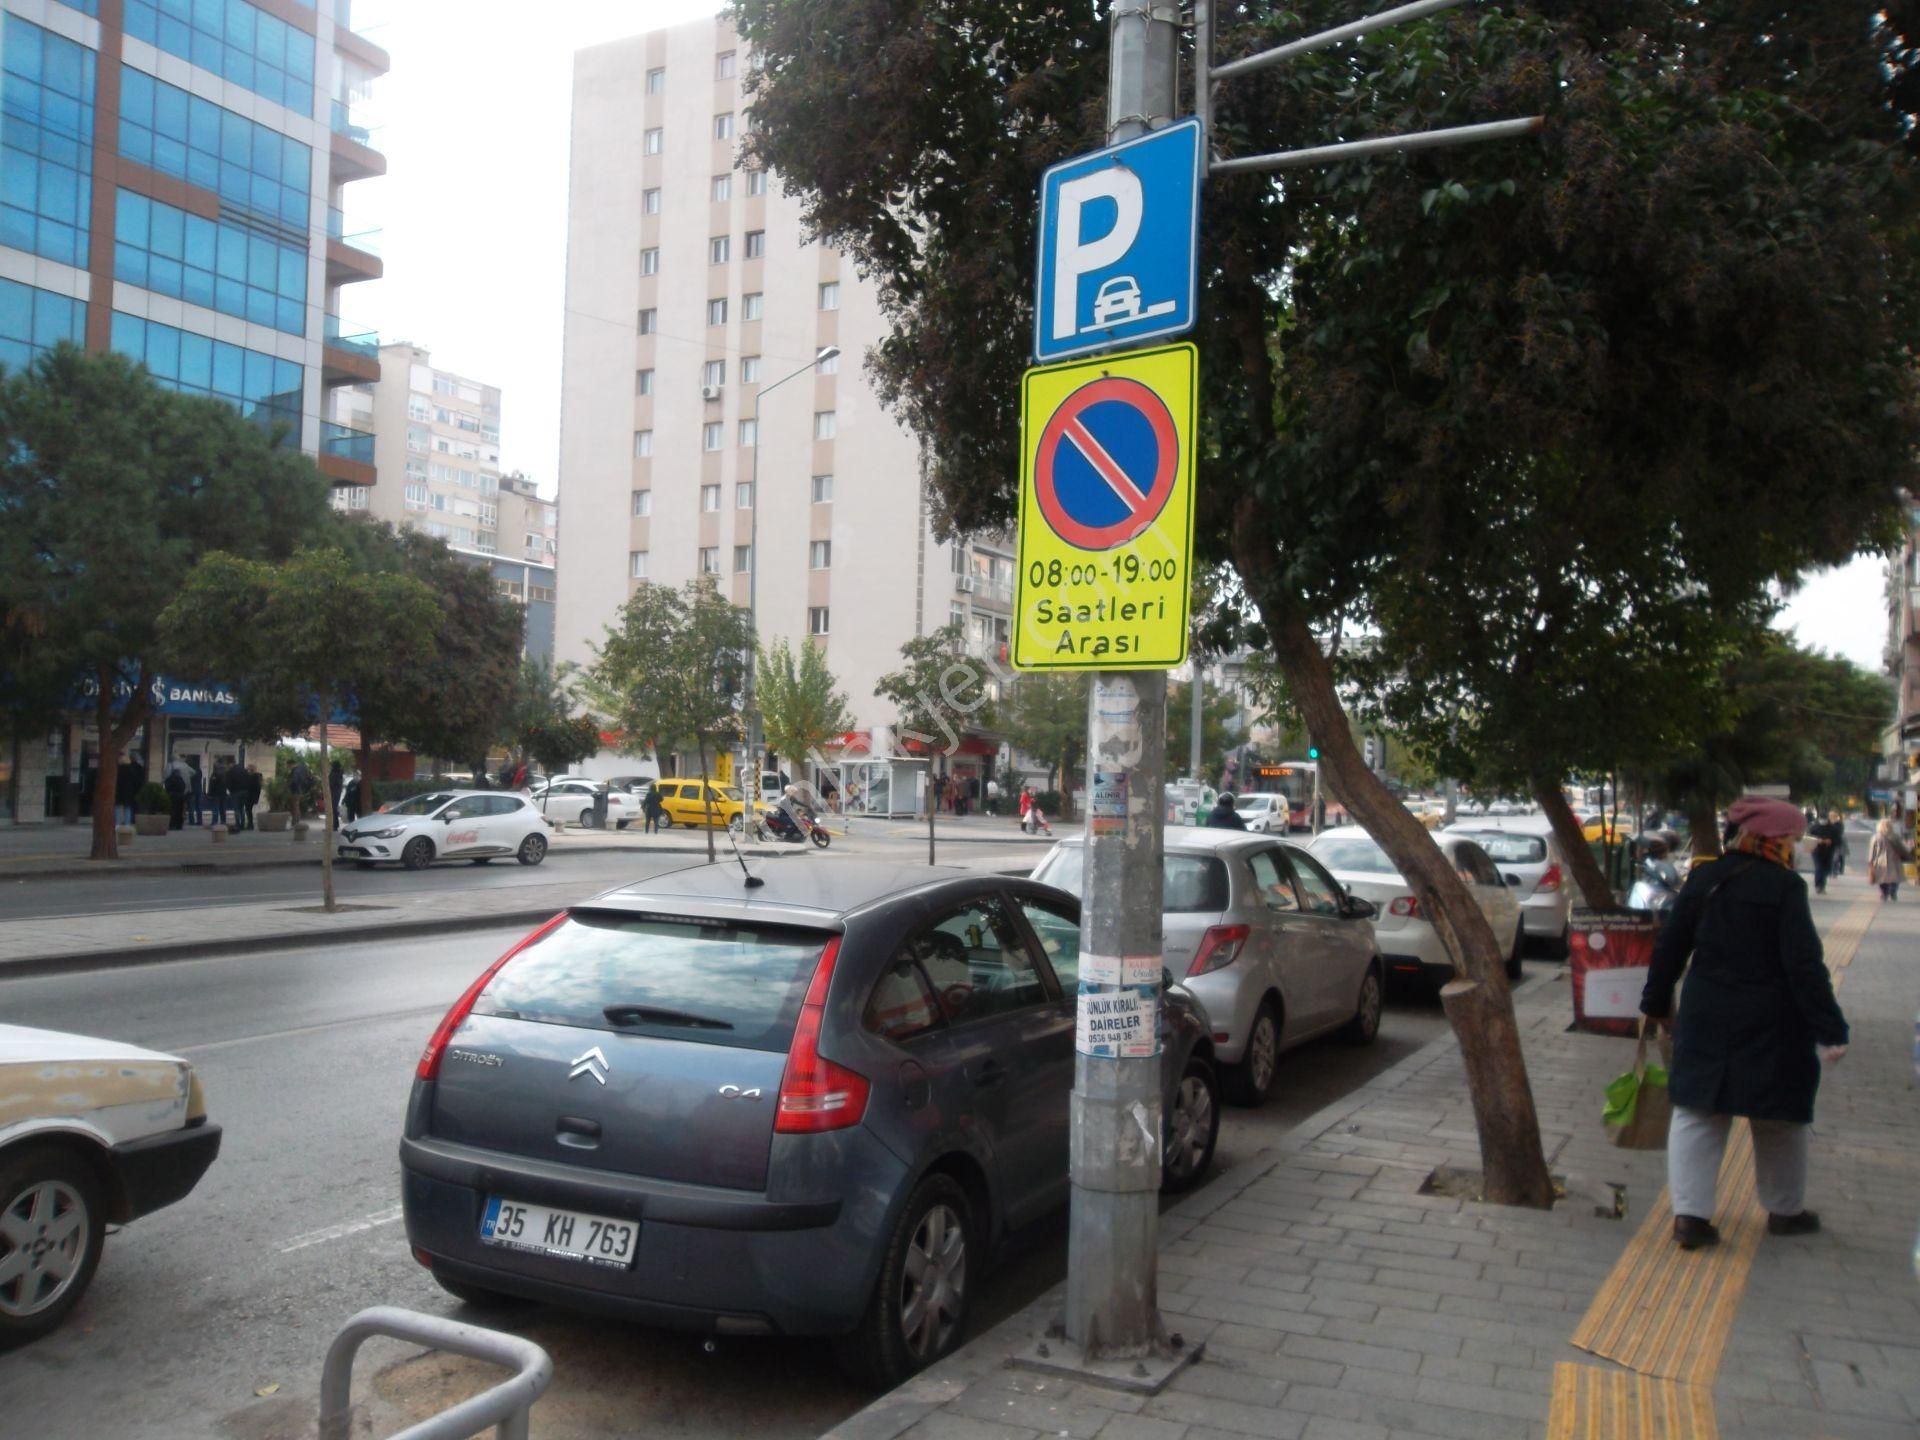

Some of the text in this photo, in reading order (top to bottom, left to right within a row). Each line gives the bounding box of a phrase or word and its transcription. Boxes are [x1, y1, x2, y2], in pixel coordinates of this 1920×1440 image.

[1053, 167, 1143, 340] P
[1036, 595, 1164, 624] Saatleri
[1055, 630, 1139, 656] Arası
[1090, 1015, 1141, 1031] DAİRELER
[719, 1084, 762, 1101] C4
[497, 1206, 527, 1237] 35
[544, 1212, 575, 1247] KH
[585, 1220, 631, 1257] 763
